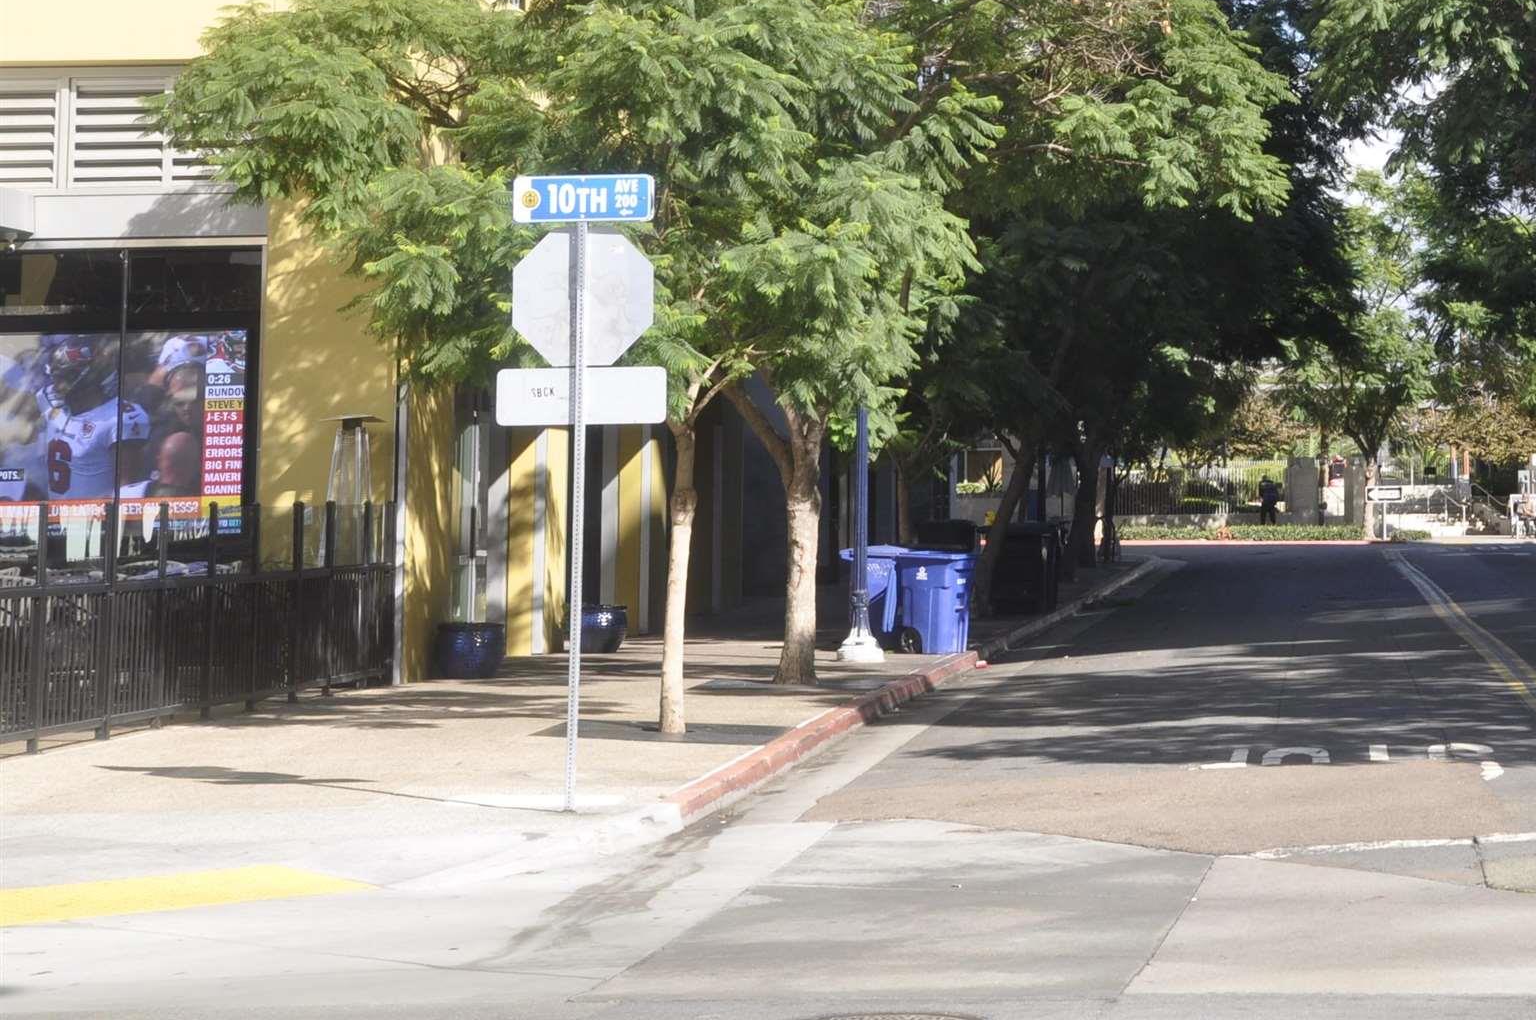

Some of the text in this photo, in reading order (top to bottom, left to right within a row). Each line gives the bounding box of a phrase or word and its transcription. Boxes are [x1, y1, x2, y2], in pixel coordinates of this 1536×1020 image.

[614, 179, 639, 193] AVE
[547, 183, 607, 214] 10TH
[615, 194, 638, 208] 200
[207, 374, 231, 385] 0:26
[207, 400, 235, 409] STEVE
[206, 423, 233, 434] BUSH
[204, 460, 223, 470] BIG
